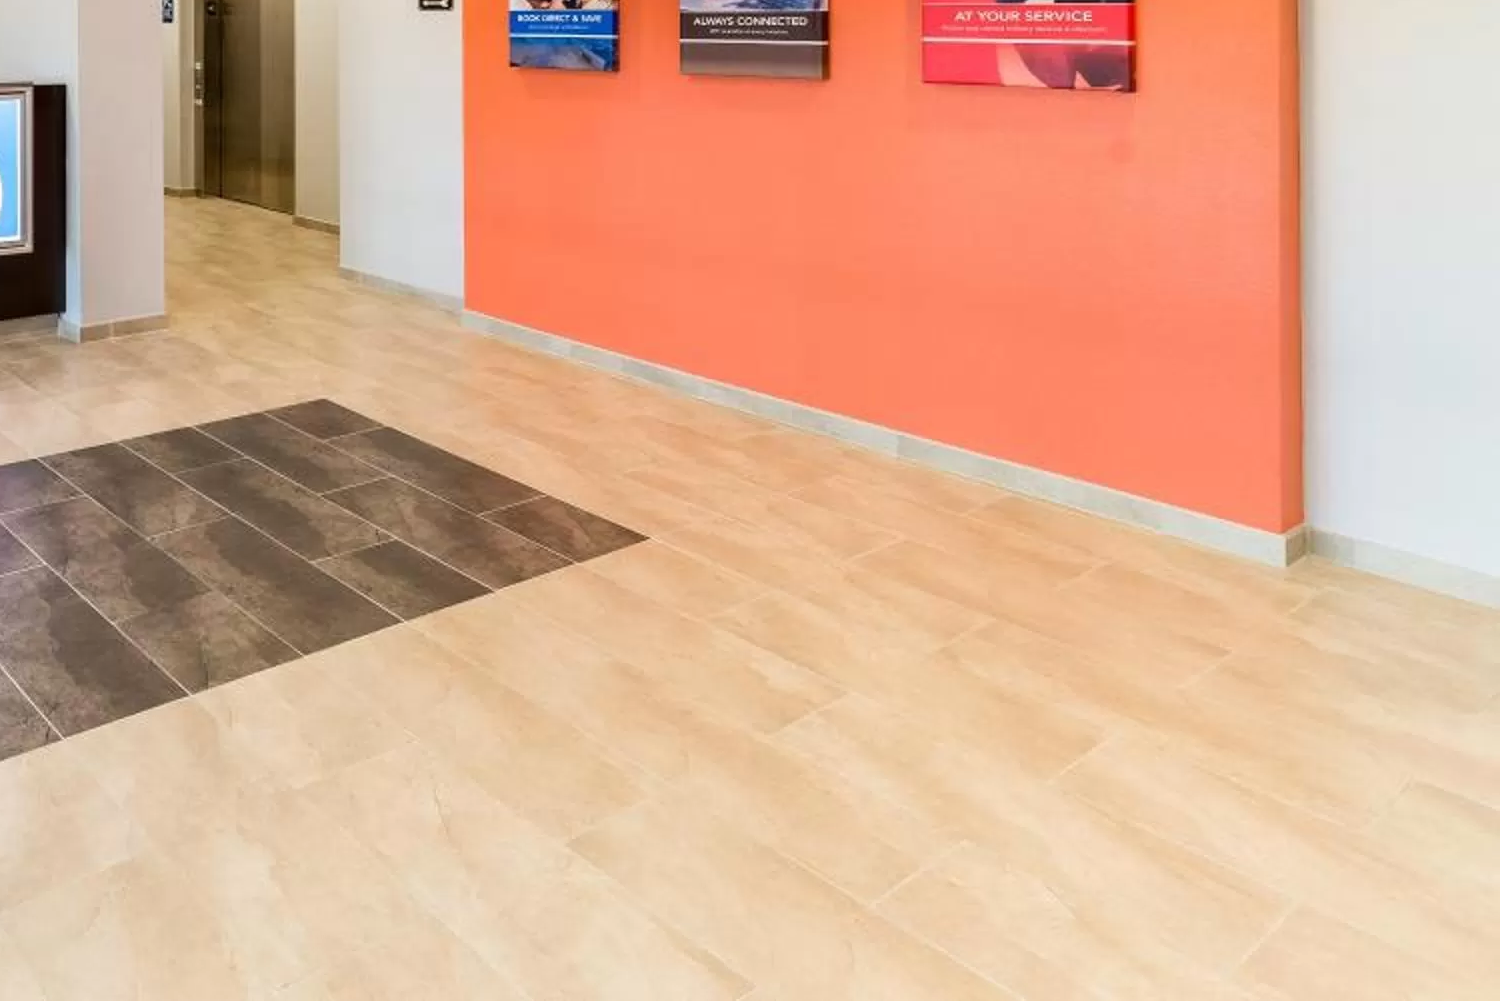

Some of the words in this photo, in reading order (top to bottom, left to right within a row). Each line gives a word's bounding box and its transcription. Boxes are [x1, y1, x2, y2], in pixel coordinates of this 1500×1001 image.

[517, 14, 541, 23] BOOK
[571, 14, 579, 23] &
[693, 15, 735, 26] ALWAYS
[736, 15, 809, 27] CONNECTED
[954, 10, 973, 22] AT
[978, 10, 1021, 22] YOUR
[1024, 10, 1093, 22] SERVICE
